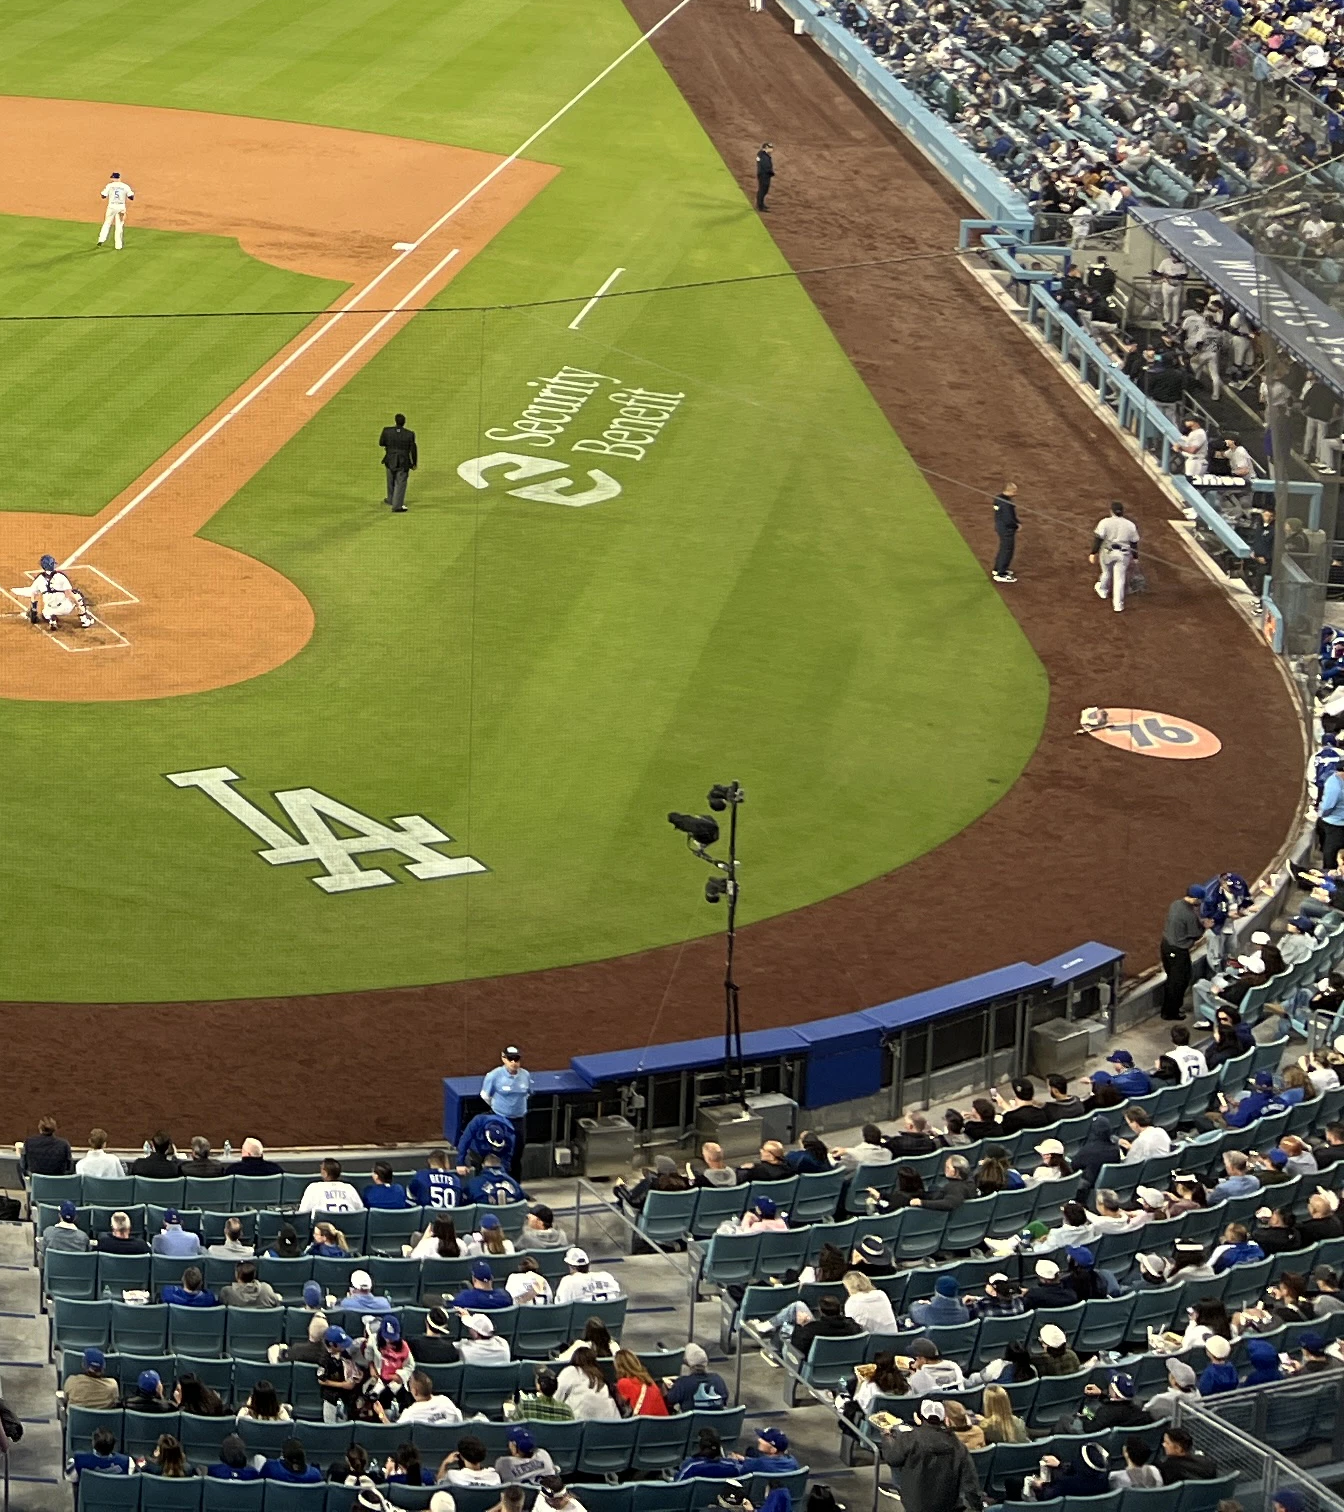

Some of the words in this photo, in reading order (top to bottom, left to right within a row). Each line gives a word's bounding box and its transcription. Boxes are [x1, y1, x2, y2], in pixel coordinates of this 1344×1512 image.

[484, 365, 622, 448] Security
[571, 387, 685, 461] Benefit
[1107, 717, 1201, 750] 76
[165, 765, 488, 893] LA
[324, 1189, 347, 1200] BETTS
[429, 1174, 454, 1186] BETTS
[430, 1186, 456, 1208] 50
